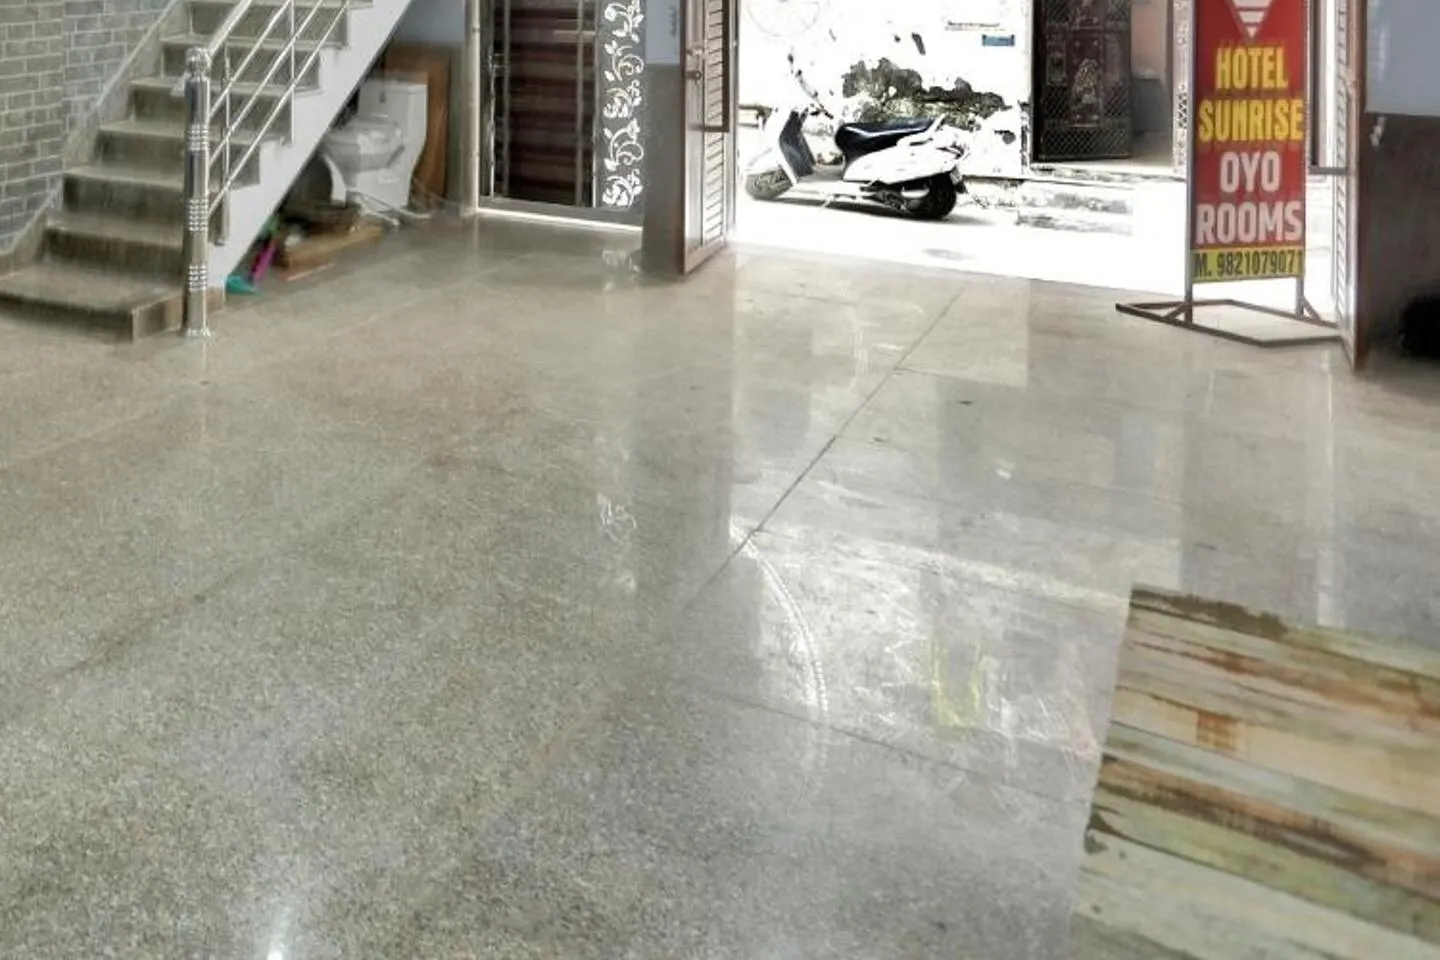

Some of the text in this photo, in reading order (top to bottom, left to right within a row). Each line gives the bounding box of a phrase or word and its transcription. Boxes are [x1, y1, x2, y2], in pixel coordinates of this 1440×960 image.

[1216, 47, 1288, 89] HOTEL
[1199, 99, 1304, 142] SUNRISE
[1220, 151, 1282, 193] OYO
[1196, 201, 1302, 244] ROOMS
